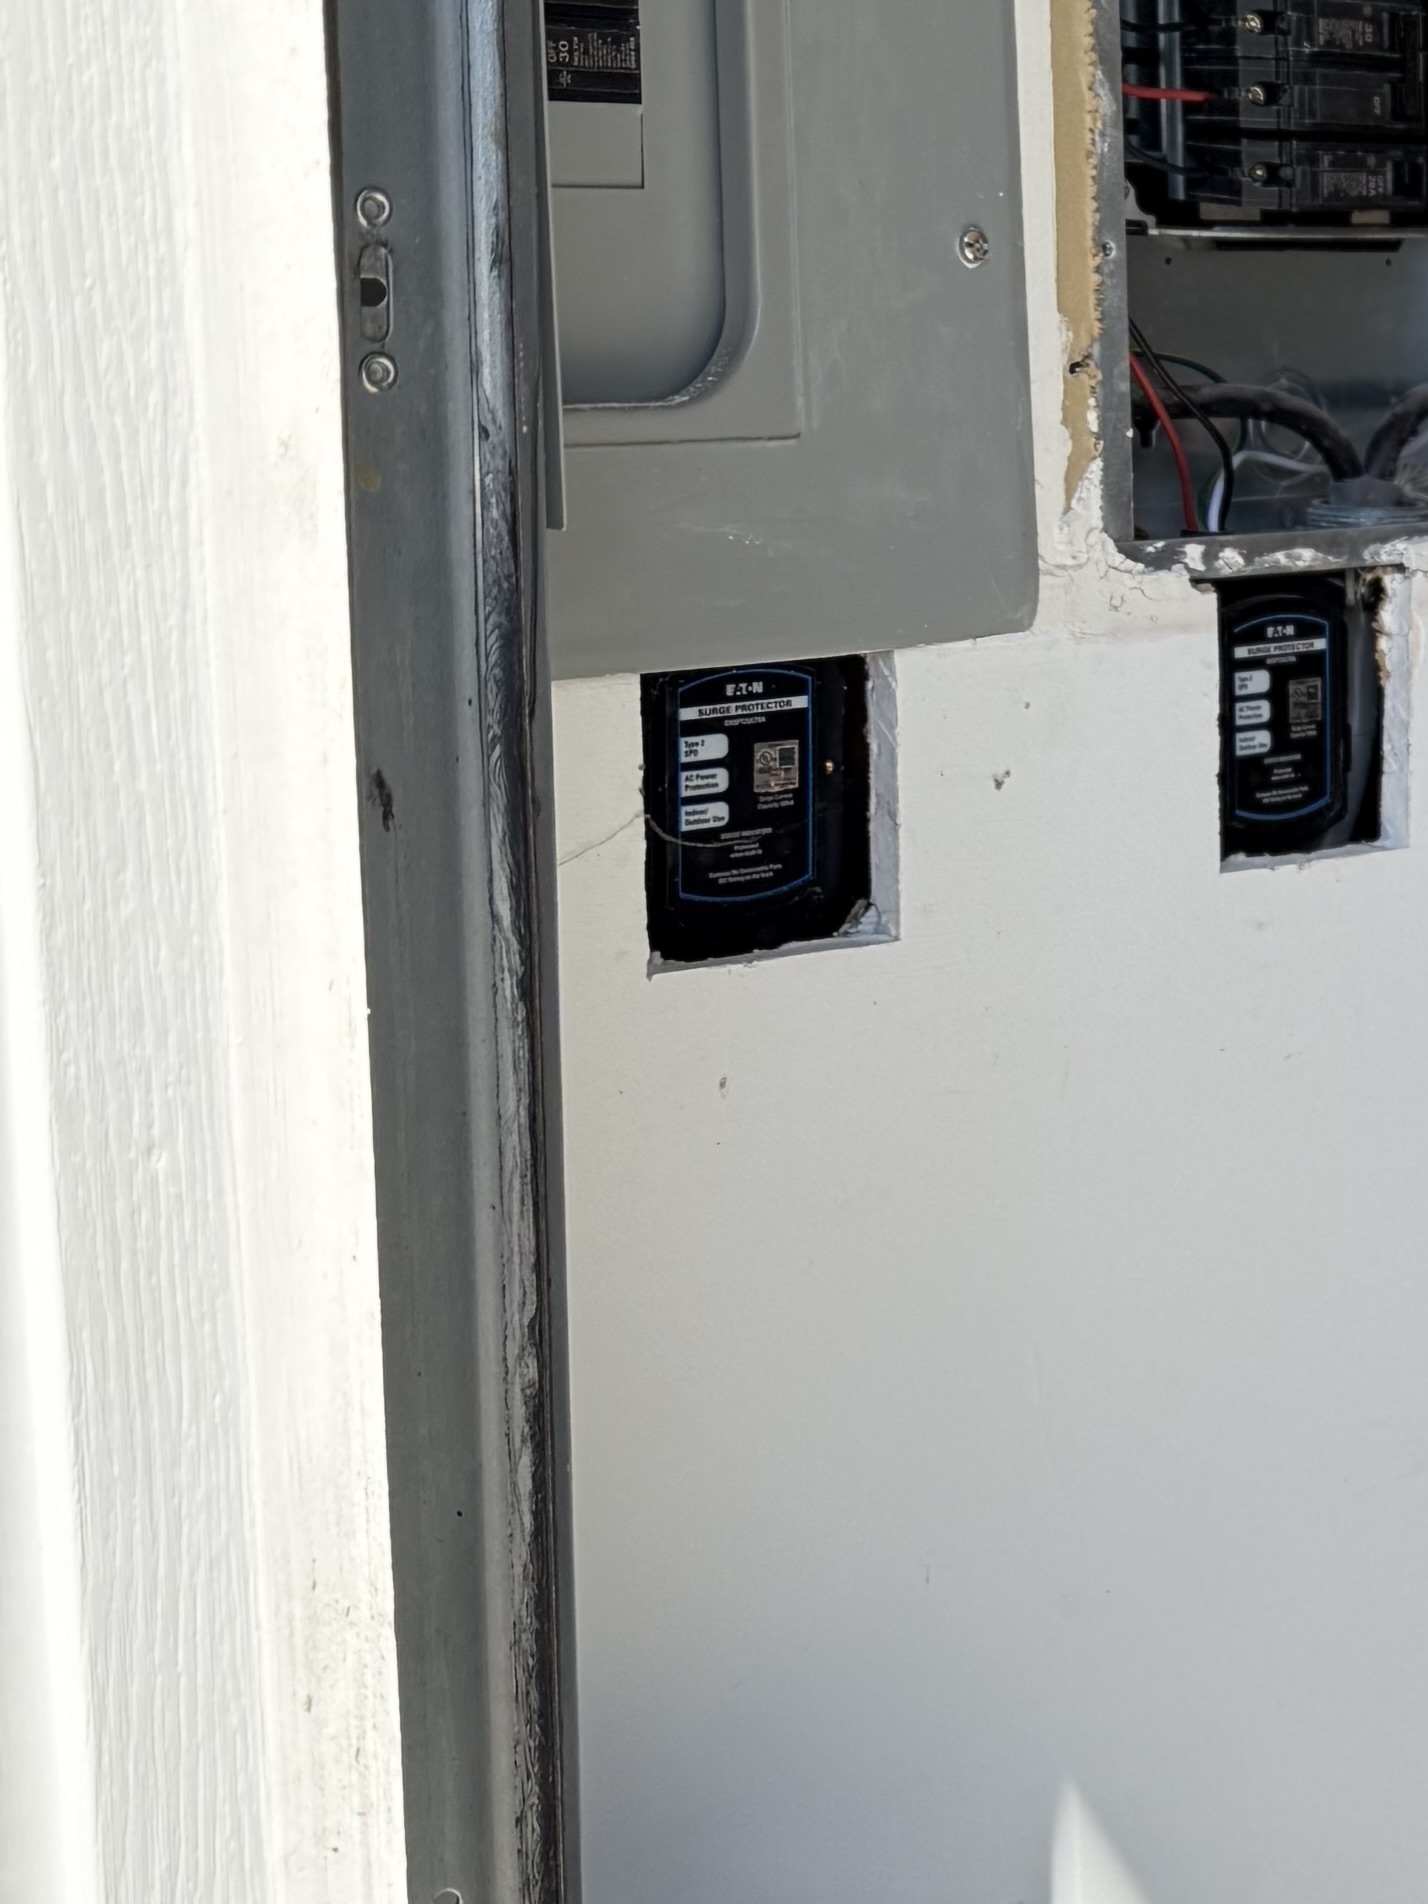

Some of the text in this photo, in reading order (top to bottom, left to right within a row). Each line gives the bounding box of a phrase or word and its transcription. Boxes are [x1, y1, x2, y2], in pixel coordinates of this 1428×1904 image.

[559, 40, 570, 63] 30
[697, 698, 793, 717] SURGE PROTECTOR
